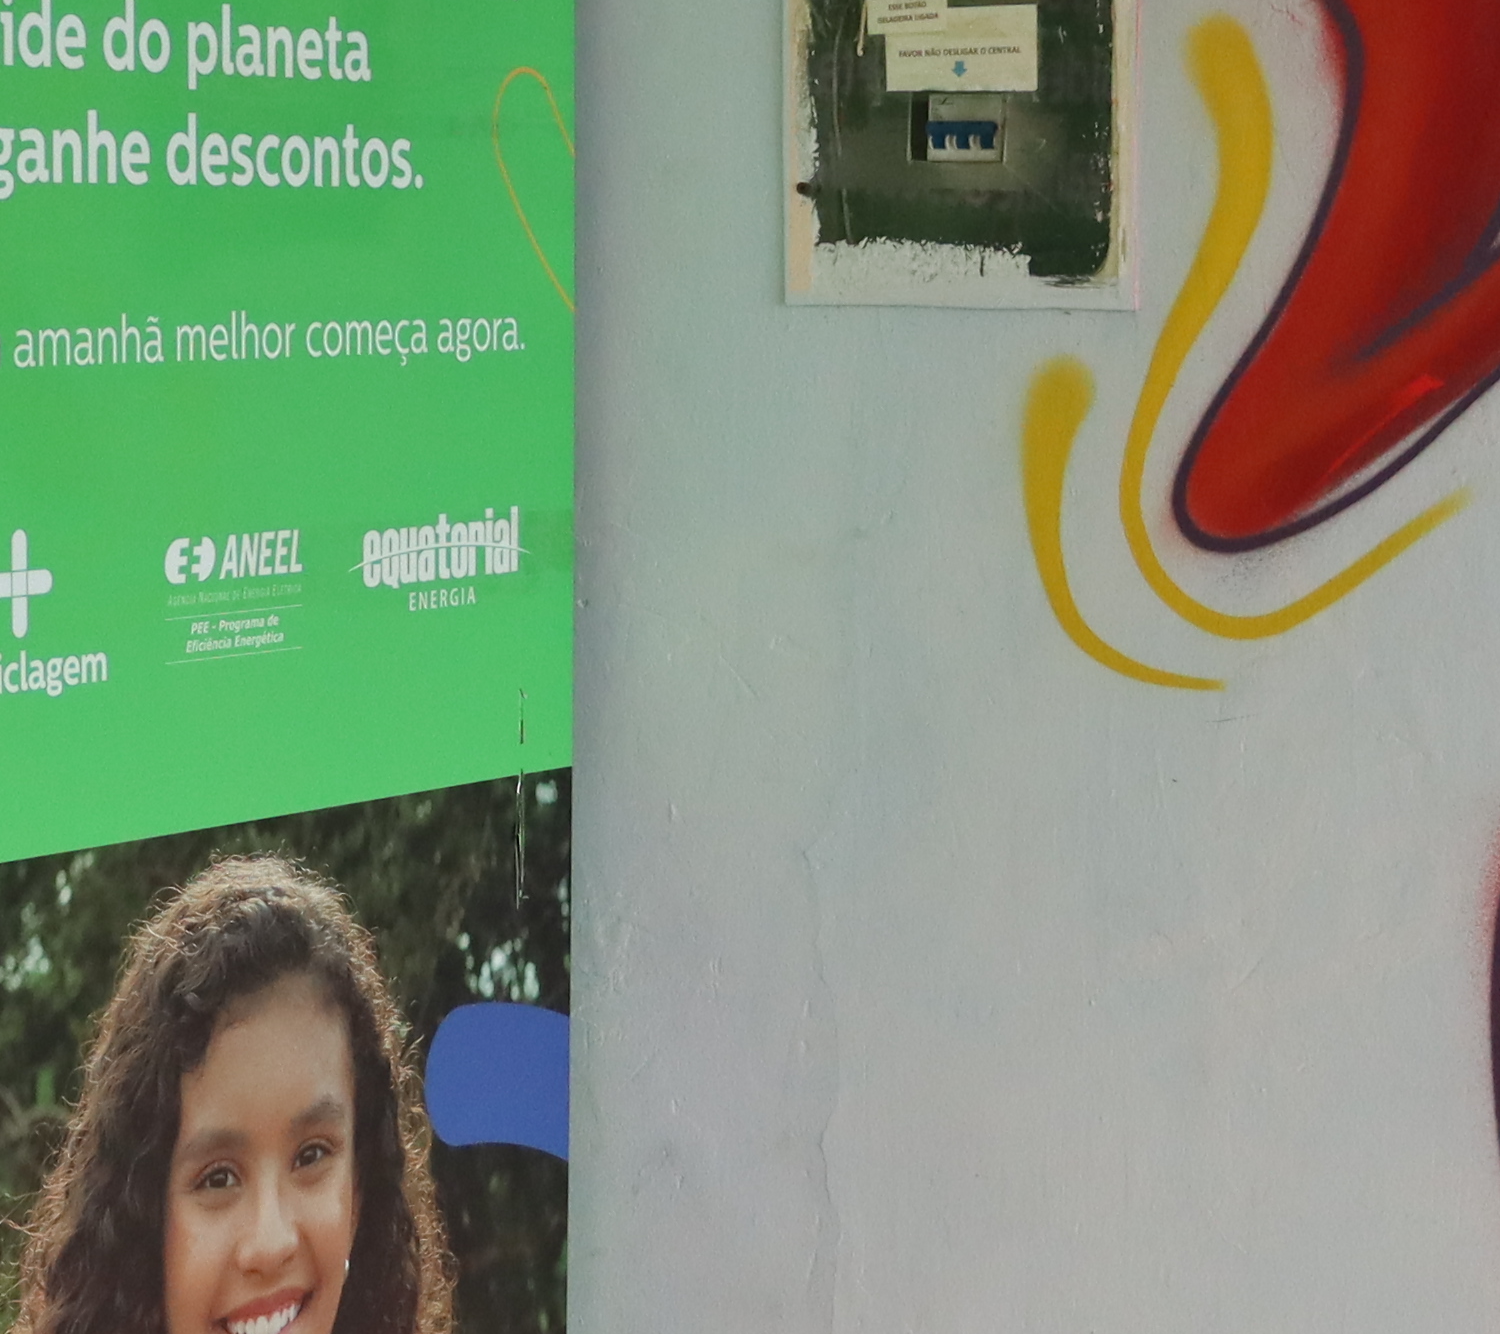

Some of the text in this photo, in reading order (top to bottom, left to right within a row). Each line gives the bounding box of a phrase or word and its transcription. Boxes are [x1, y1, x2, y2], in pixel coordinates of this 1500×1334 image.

[888, 0, 927, 11] ESSE BOTÃO
[187, 3, 372, 90] planeta
[898, 45, 1022, 58] FAVOR NÃO DESLIGAR O CENTRAL
[166, 112, 424, 190] descontos.
[13, 313, 165, 368] amanhã
[176, 310, 296, 362] melhor
[306, 316, 428, 365] começa
[437, 315, 526, 362] agora.
[218, 529, 303, 581] ANEEL
[362, 505, 519, 590] equatorial
[409, 586, 476, 612] ENERGIA
[185, 631, 285, 654] Eficiência Energética
[190, 613, 280, 635] PEE Programa de
